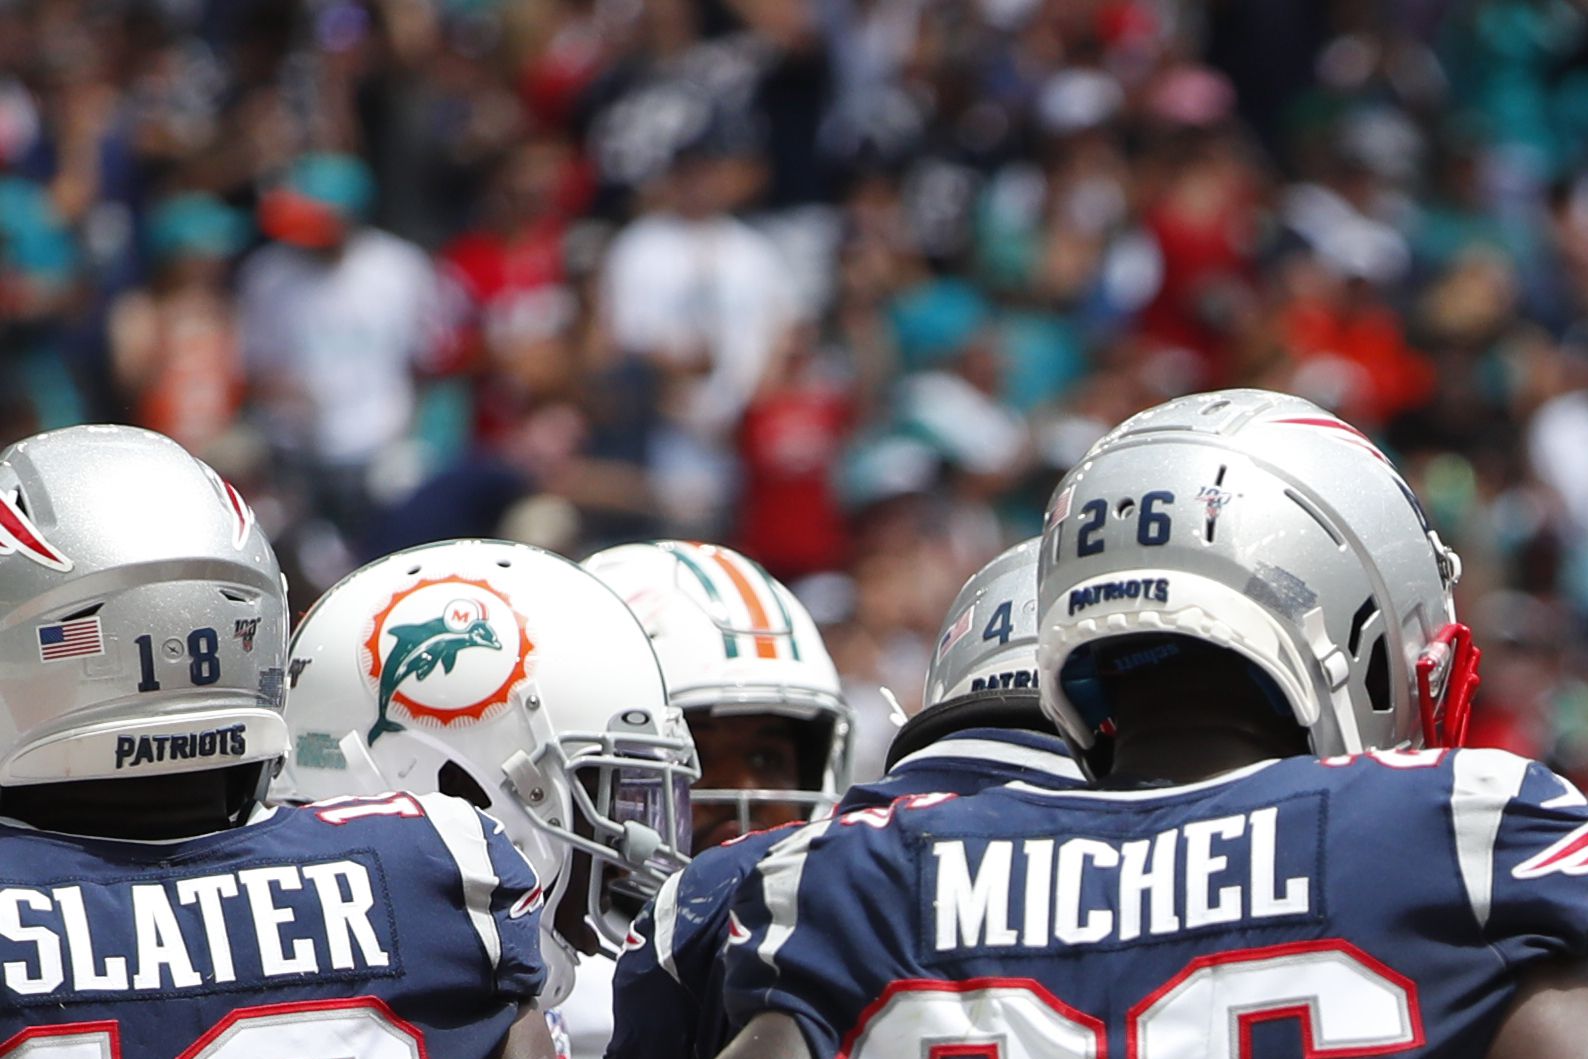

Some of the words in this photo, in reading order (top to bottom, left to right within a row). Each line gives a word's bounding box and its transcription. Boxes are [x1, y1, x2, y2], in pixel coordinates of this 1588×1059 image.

[1077, 490, 1175, 557] 26
[1068, 578, 1169, 616] PATRIOTS
[134, 627, 221, 692] 18
[115, 723, 246, 769] PATRIOTS
[935, 807, 1309, 950] MICHEL
[0, 860, 389, 995] SLATER
